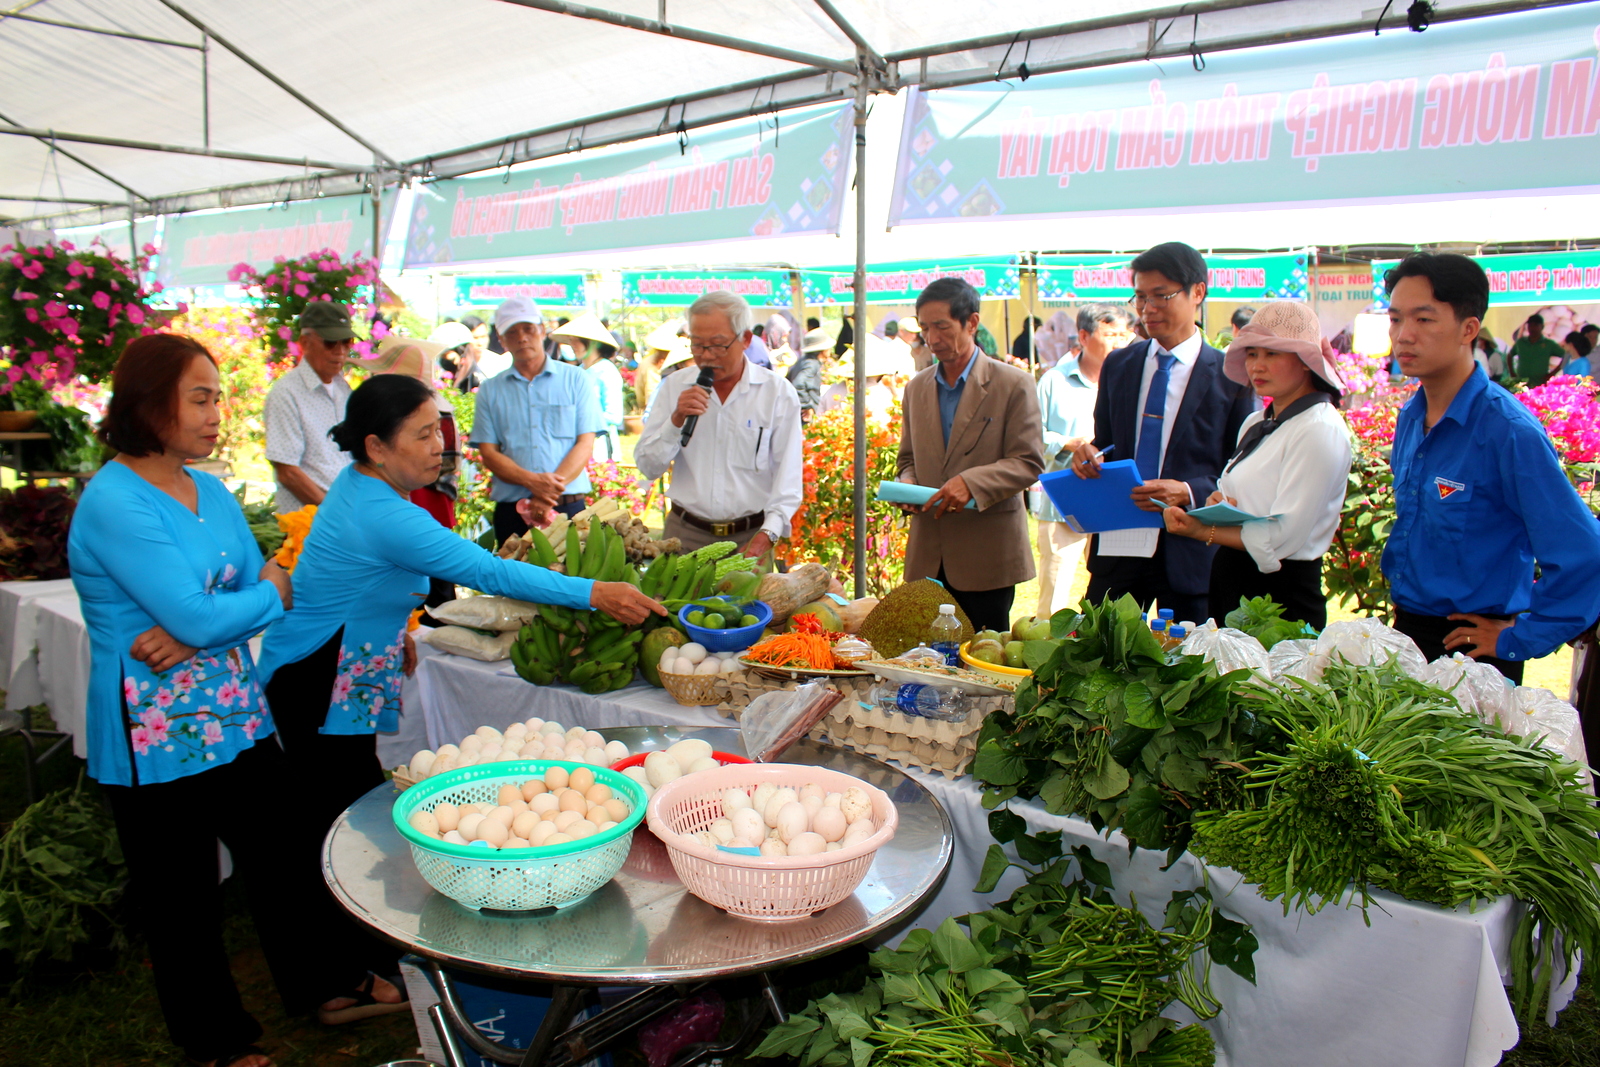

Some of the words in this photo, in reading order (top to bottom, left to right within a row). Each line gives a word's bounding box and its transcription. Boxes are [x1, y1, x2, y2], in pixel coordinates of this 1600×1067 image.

[1236, 268, 1266, 288] TRUNG
[1486, 267, 1508, 292] ÔNG
[1509, 265, 1550, 295] NGHIỆP
[1551, 263, 1582, 289] THÔN
